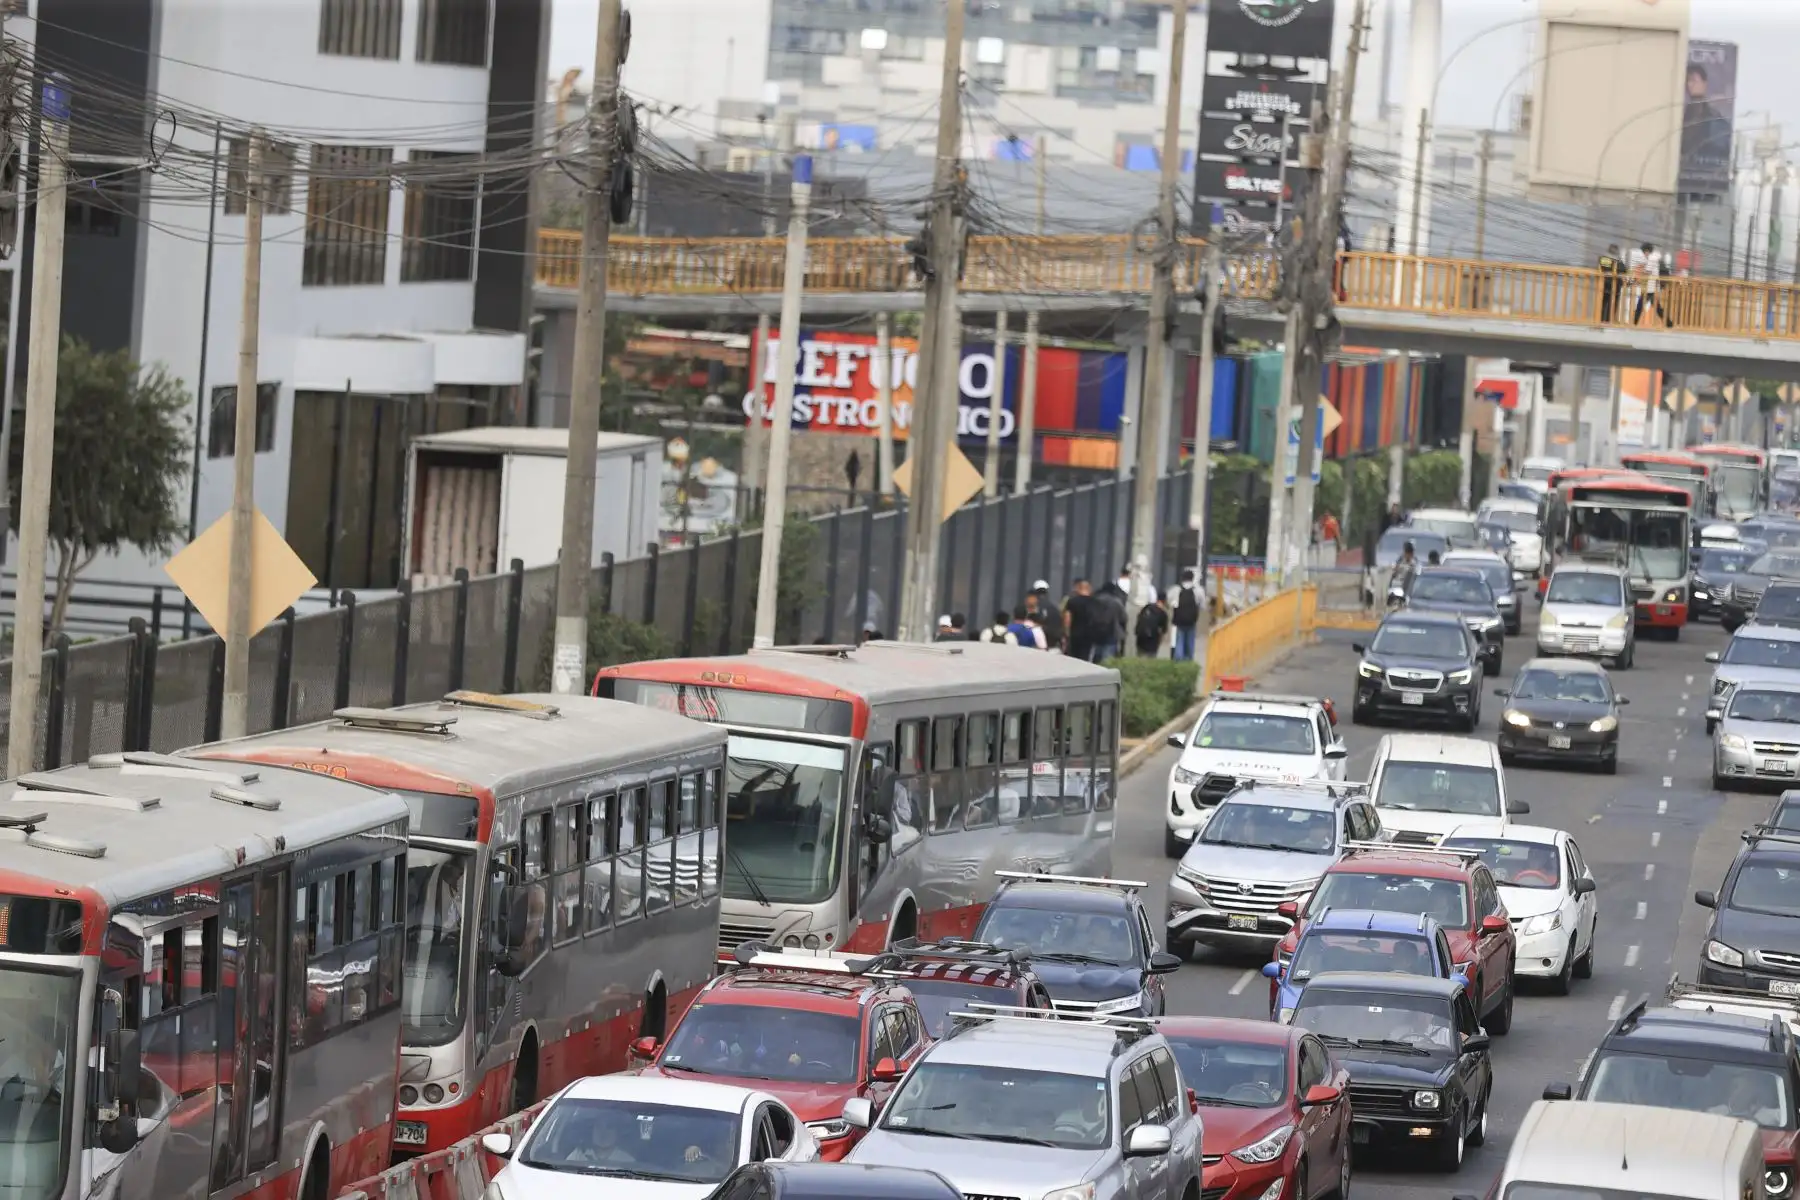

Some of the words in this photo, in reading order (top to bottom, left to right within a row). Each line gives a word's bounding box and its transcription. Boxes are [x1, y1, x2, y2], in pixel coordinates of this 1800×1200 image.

[763, 339, 995, 399] REFUO
[742, 390, 1015, 438] GSTRONICO
[1282, 775, 1300, 783] TAXI
